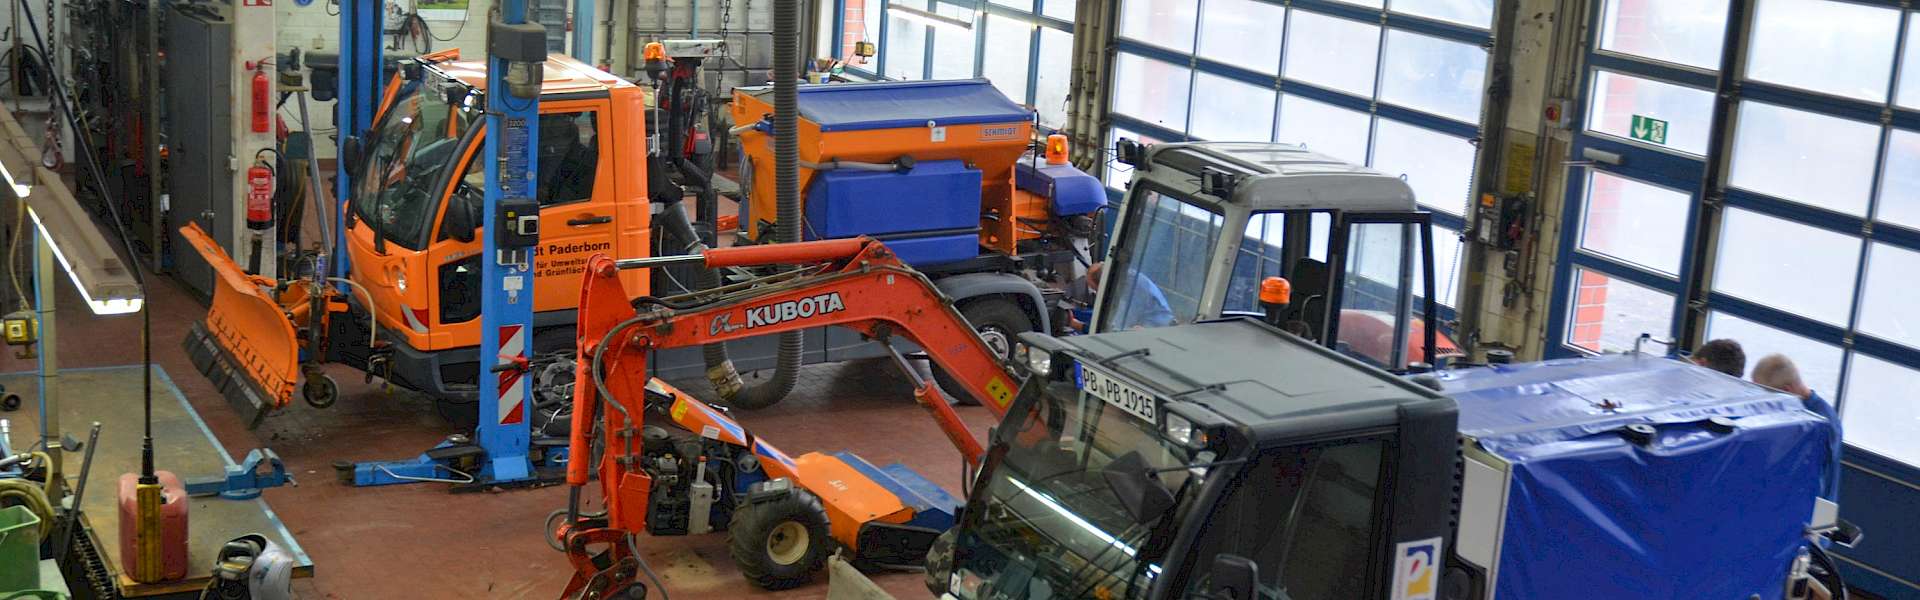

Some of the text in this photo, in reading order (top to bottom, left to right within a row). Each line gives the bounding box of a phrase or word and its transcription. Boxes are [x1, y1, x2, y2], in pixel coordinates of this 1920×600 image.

[984, 127, 1016, 136] SCHMIDT
[549, 242, 610, 255] Paderborn
[745, 292, 845, 328] KUBOTA
[1082, 367, 1153, 418] PB PB 1915
